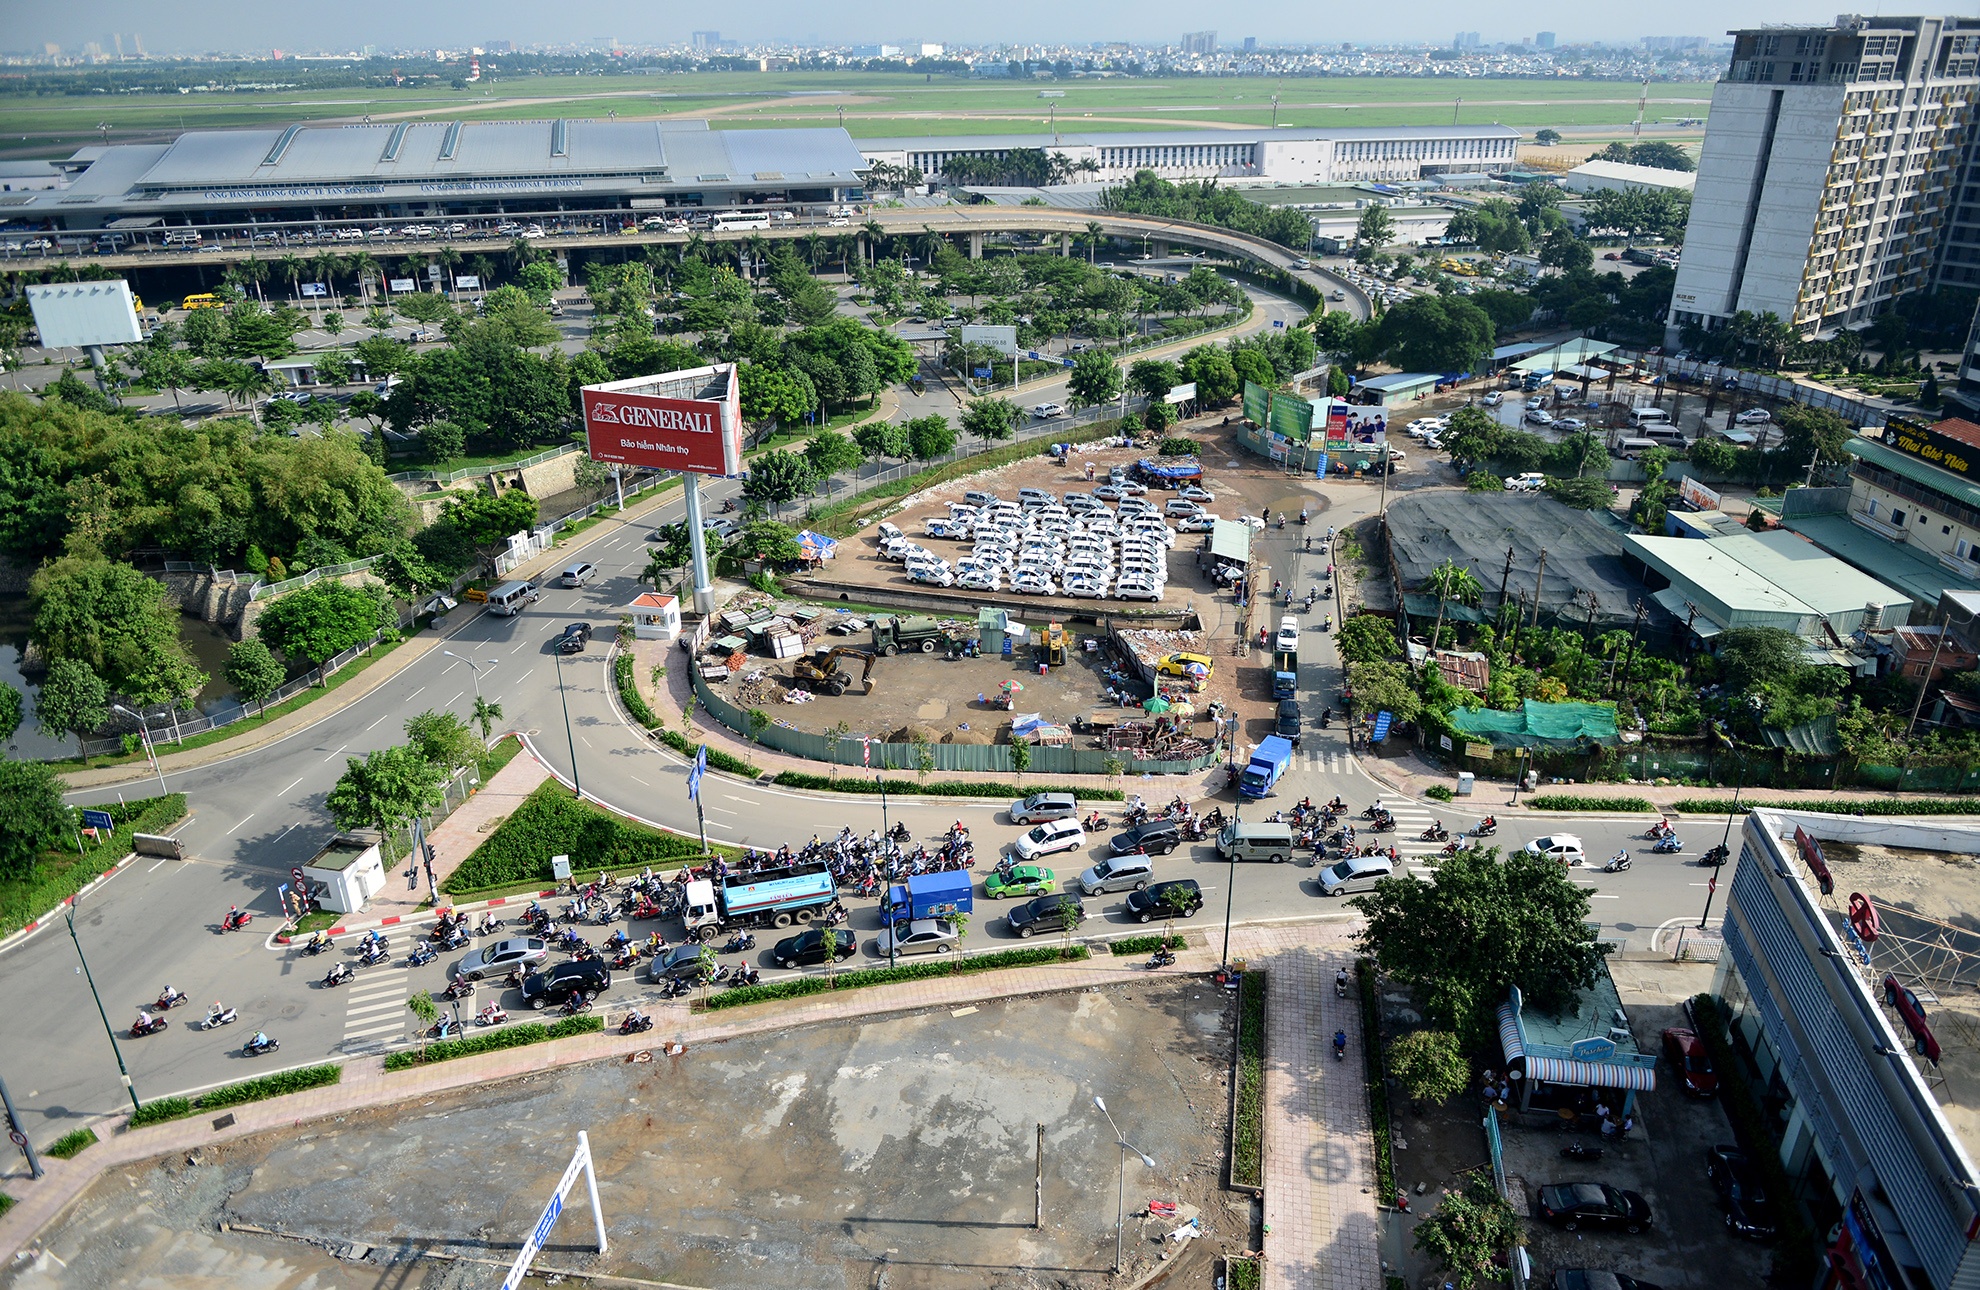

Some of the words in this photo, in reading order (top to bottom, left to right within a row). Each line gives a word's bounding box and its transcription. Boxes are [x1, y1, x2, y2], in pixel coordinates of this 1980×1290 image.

[620, 405, 713, 434] GENERALI
[620, 438, 635, 449] Bảo
[636, 440, 655, 451] hiểm
[655, 443, 675, 453] Nhân
[676, 445, 689, 456] thọ
[1898, 435, 1921, 452] Mai
[1921, 444, 1944, 461] Ghé
